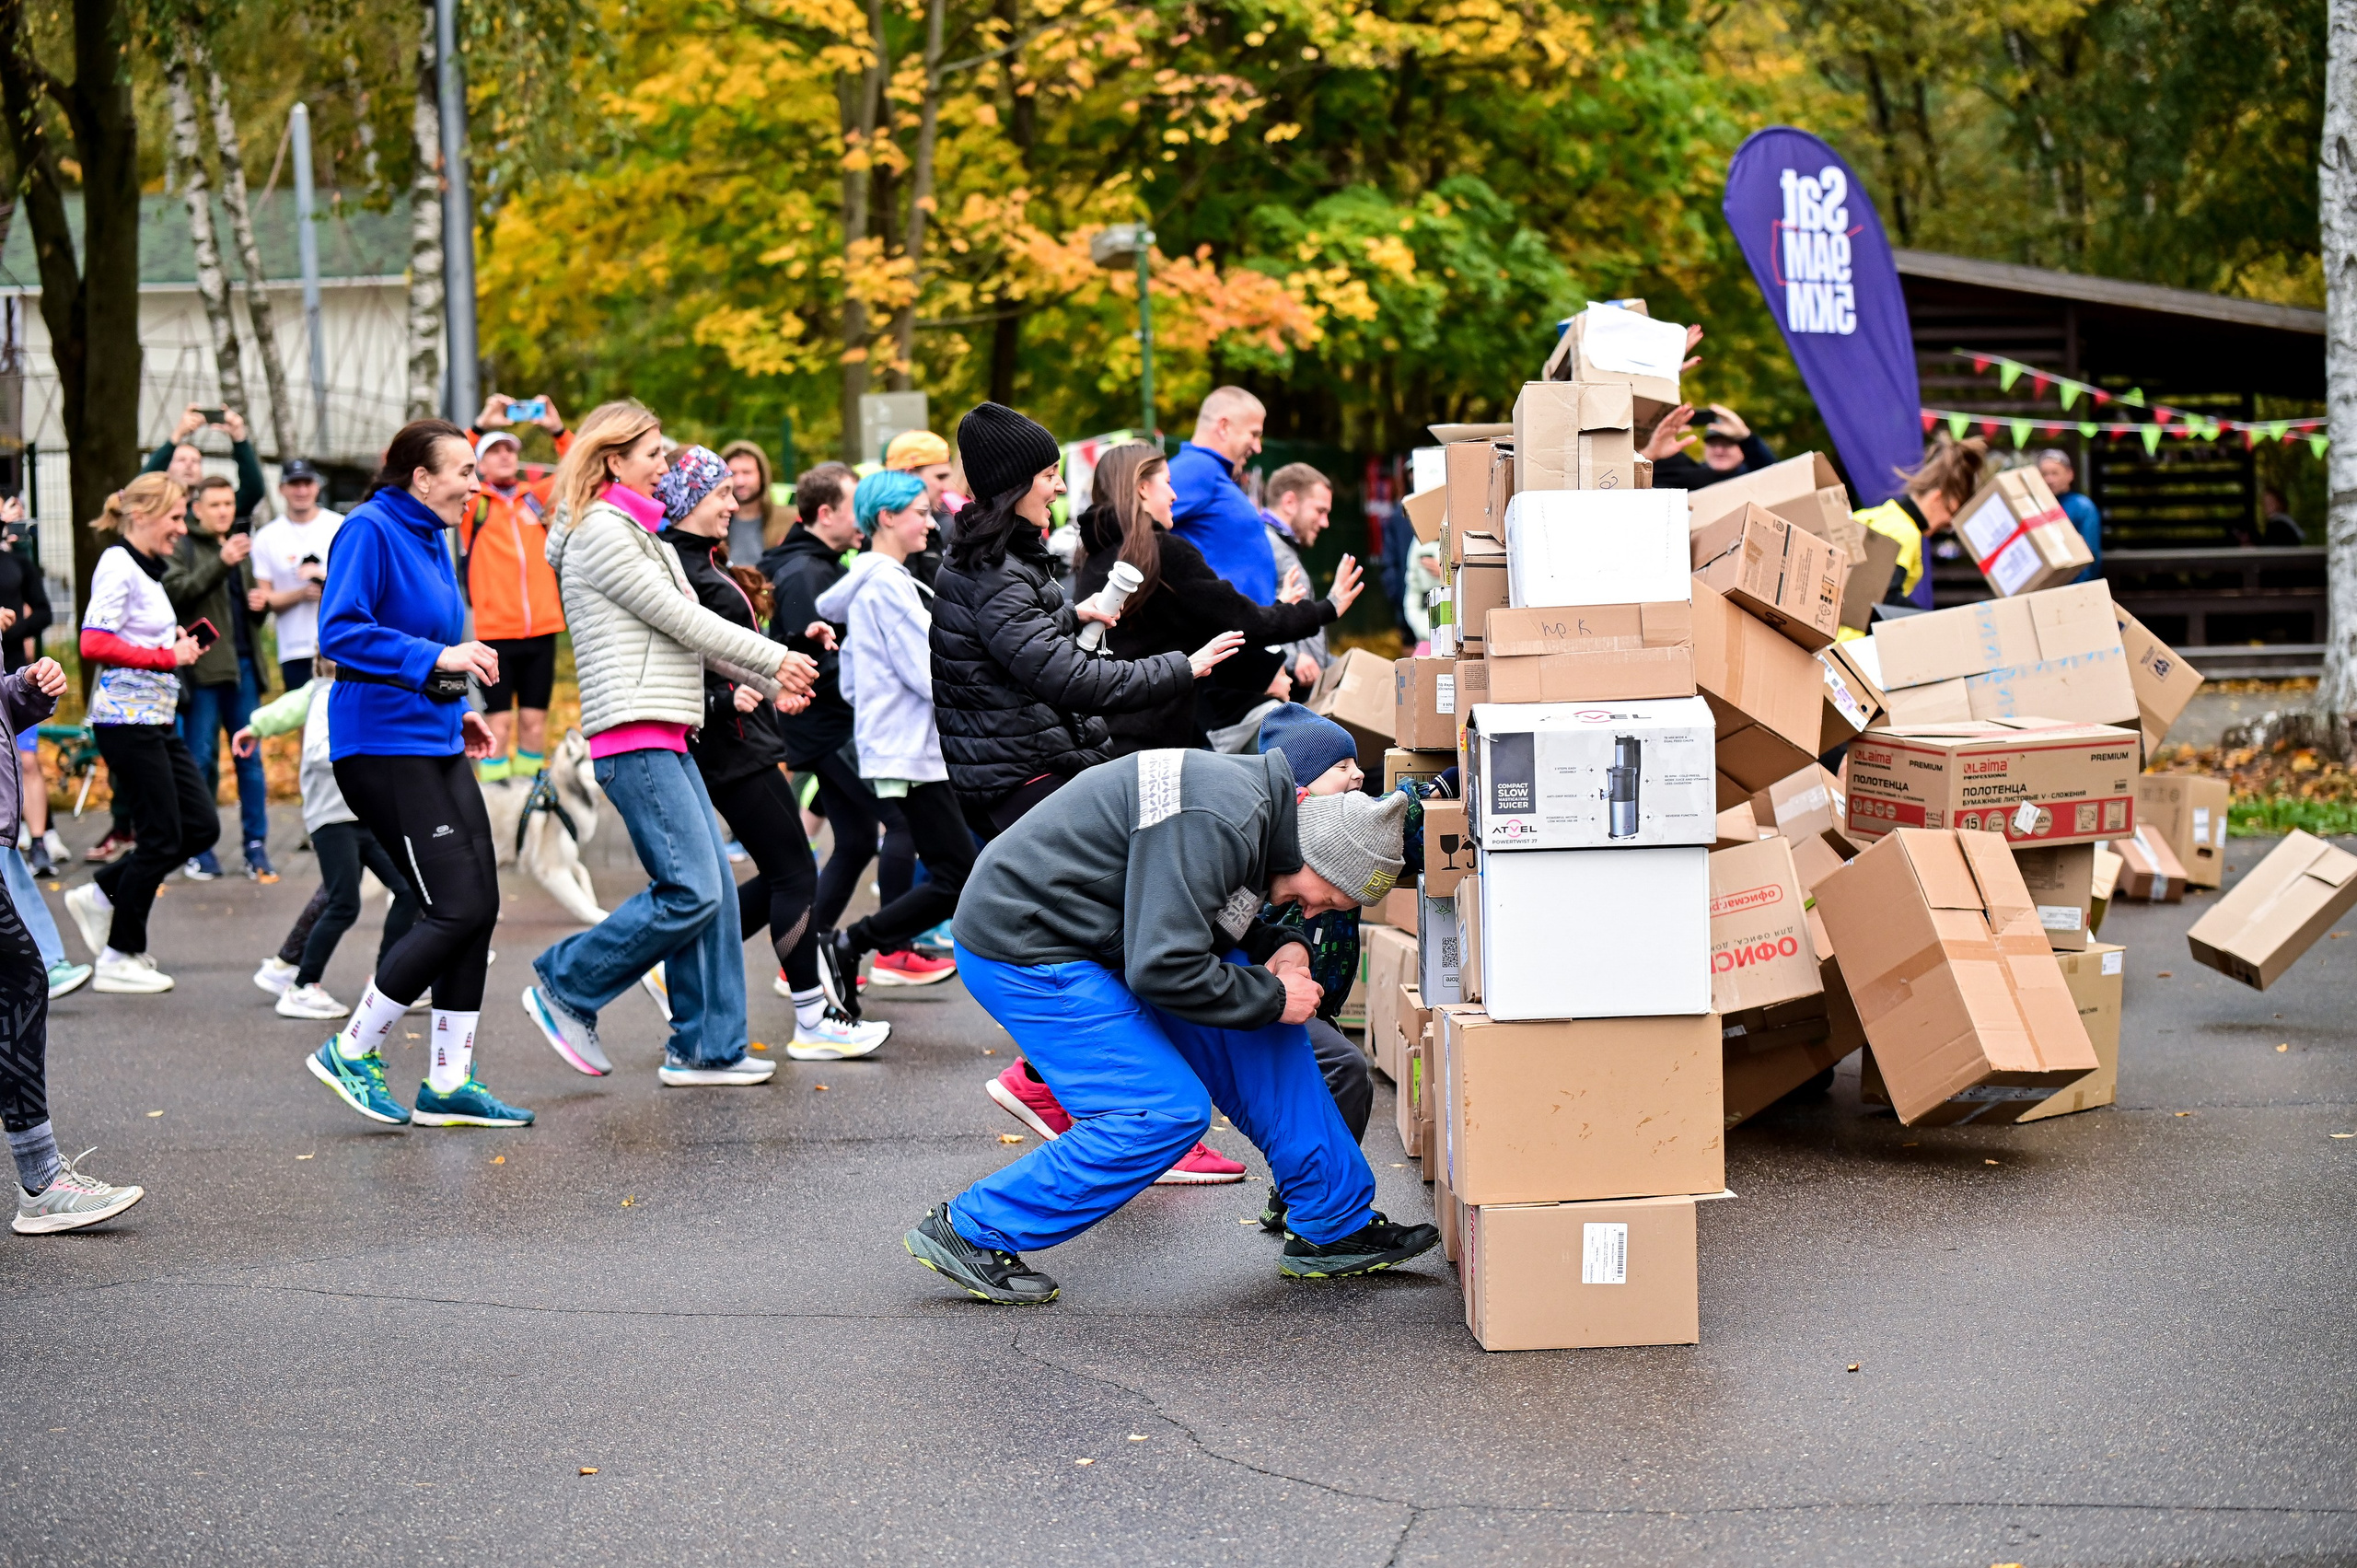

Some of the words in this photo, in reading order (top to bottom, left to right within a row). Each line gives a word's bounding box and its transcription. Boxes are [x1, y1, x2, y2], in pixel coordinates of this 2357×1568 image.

[2090, 751, 2129, 761] PREMIUM
[1909, 760, 1944, 772] PREMIUM
[1972, 759, 2008, 773] Laima
[1853, 773, 1910, 792] ПОЛОТЕНЦА
[1497, 788, 1528, 797] SLOW
[1962, 784, 2027, 797] ПОЛОТЕНЦА
[1962, 797, 2003, 807] БУМАЖНЫЕ
[2003, 794, 2039, 803] ЛИСТОВЫЕ
[2051, 790, 2087, 799] СЛОЖЕНИЯ
[1498, 801, 1528, 809] JUICER
[1965, 817, 1978, 829] 15
[1492, 825, 1538, 834] ATVEL
[1774, 926, 1794, 936] ДЛЯ
